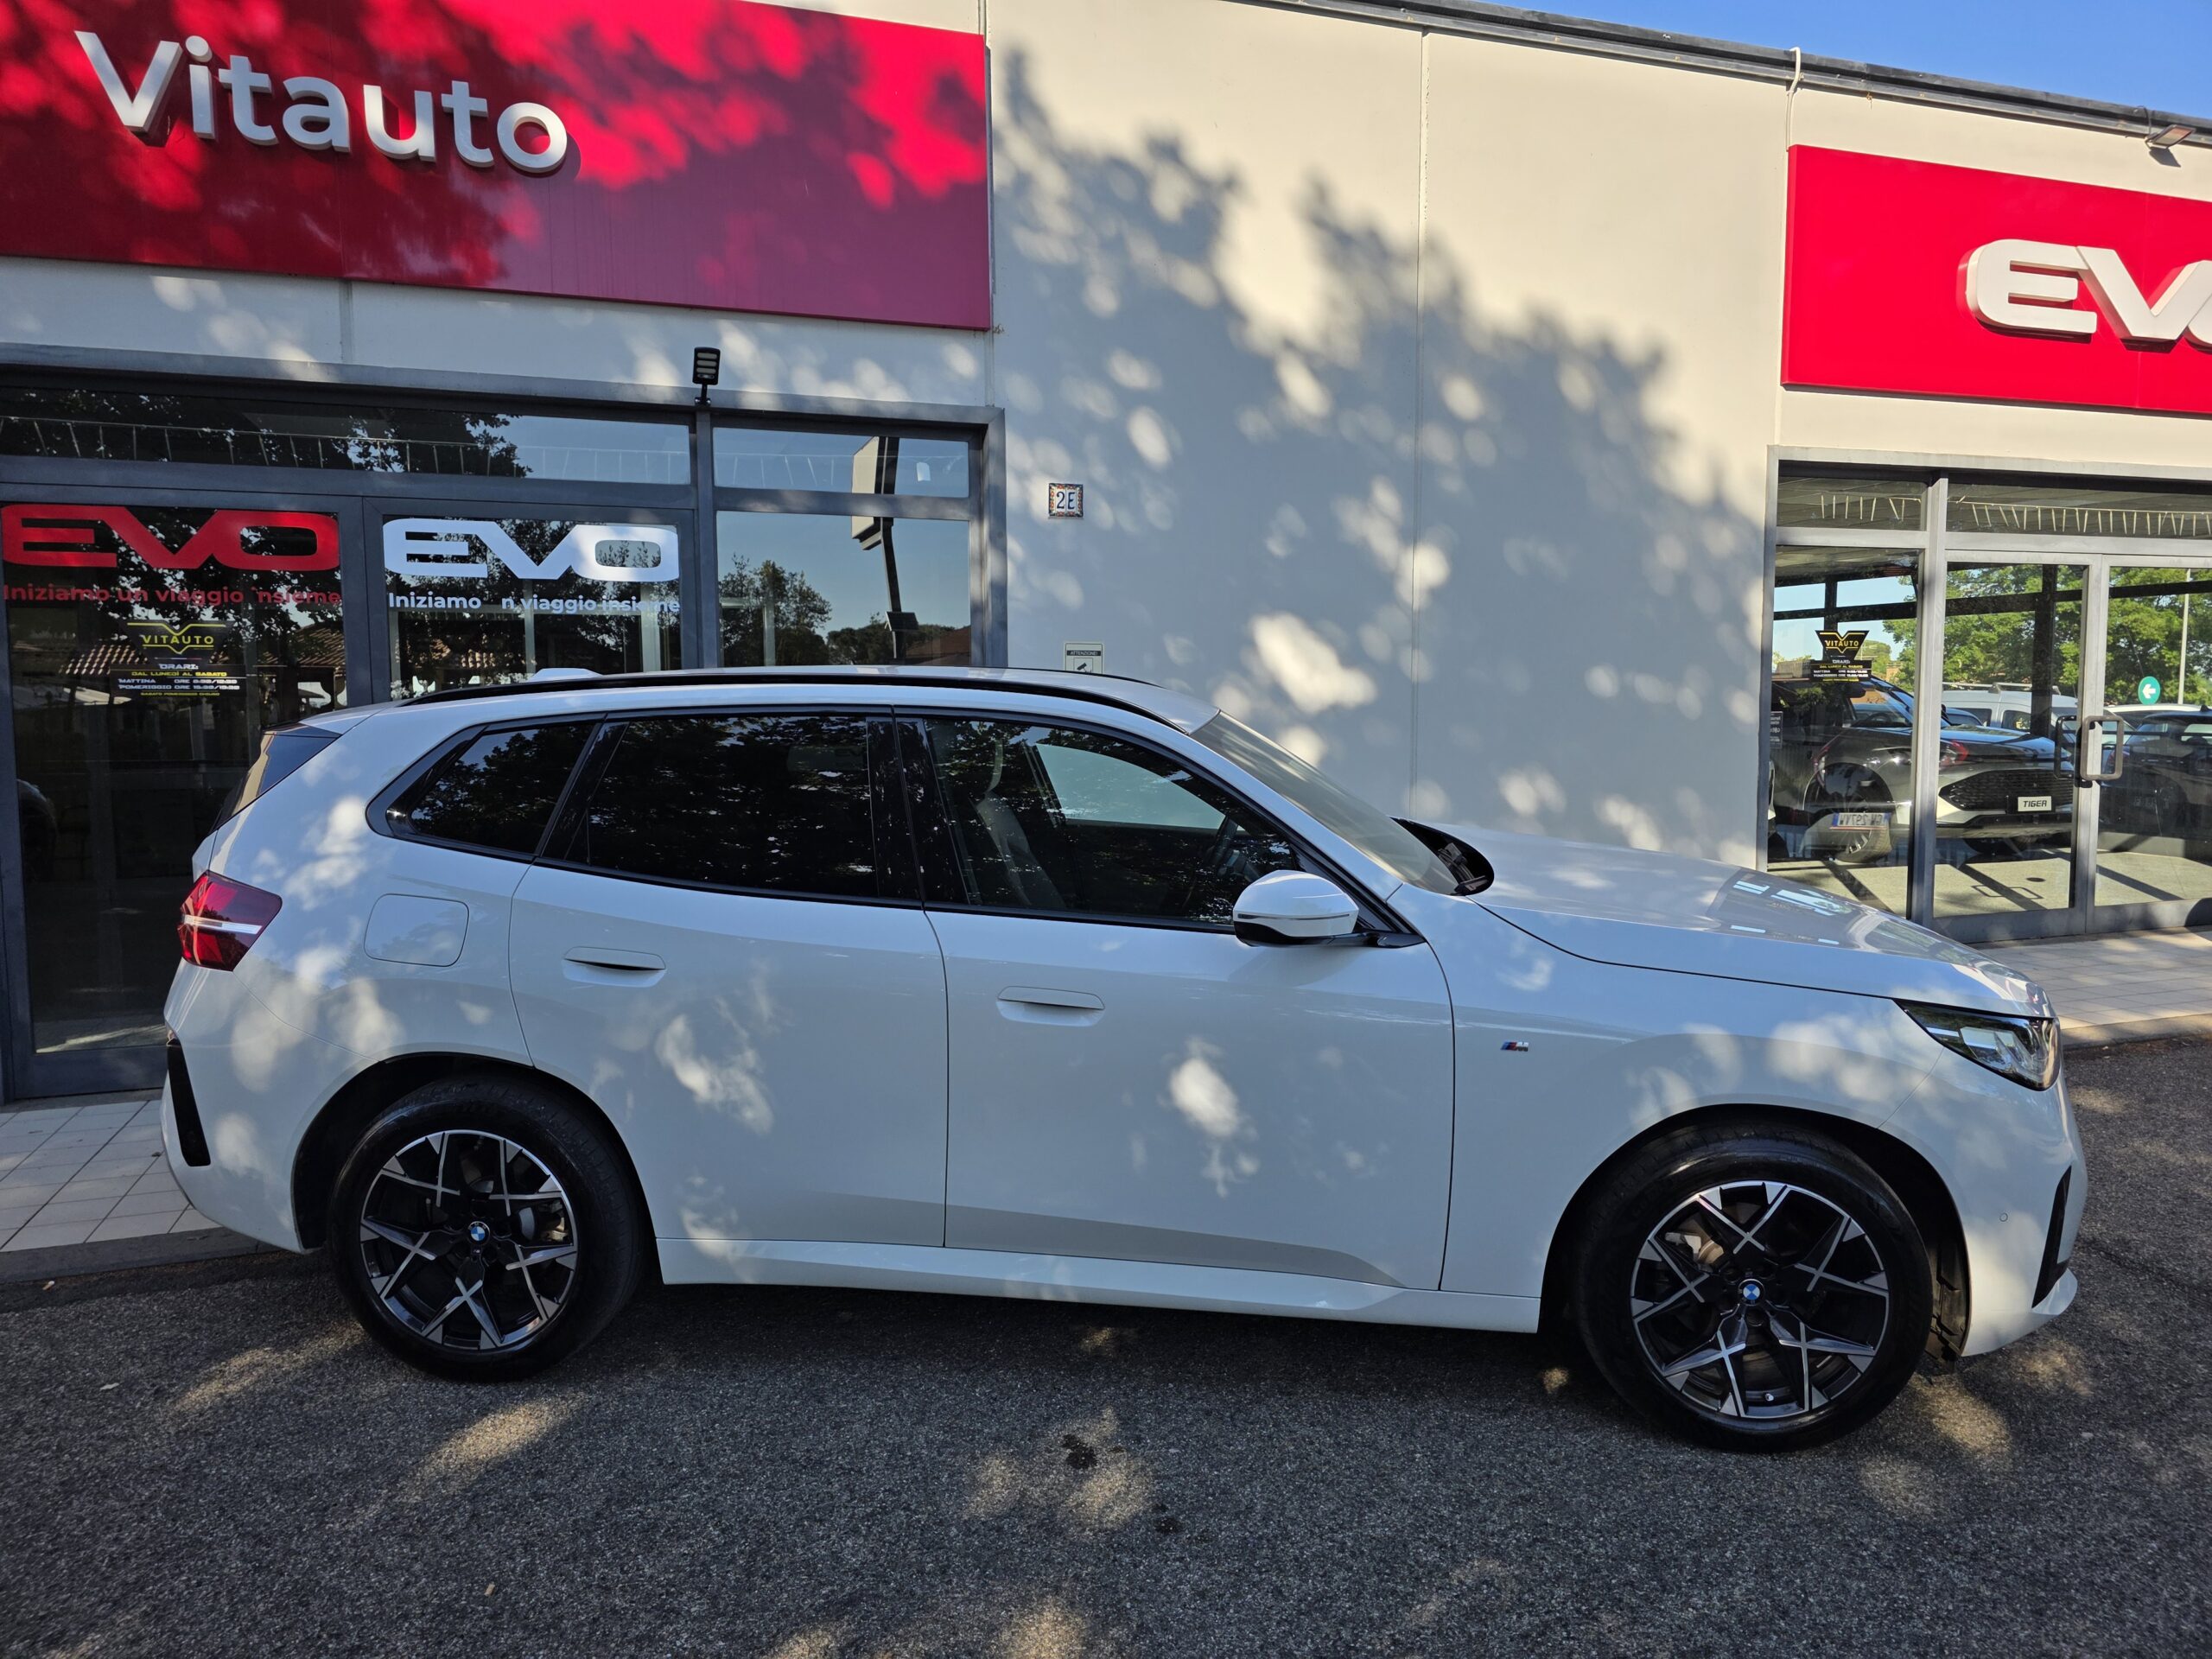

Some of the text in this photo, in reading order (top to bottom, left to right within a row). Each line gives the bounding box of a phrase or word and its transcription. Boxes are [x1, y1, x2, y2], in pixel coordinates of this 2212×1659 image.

[73, 30, 568, 173] Vitauto
[1966, 238, 2212, 348] EV
[1056, 491, 1076, 510] 2E
[1, 504, 340, 571] EVO
[383, 518, 679, 582] EVO
[3, 583, 342, 606] Iniziamo un viaggio nsieme
[389, 591, 482, 609] Iniziamo
[520, 594, 597, 613] viaggio
[141, 635, 214, 645] VITAUTO
[2023, 799, 2048, 808] TIGER
